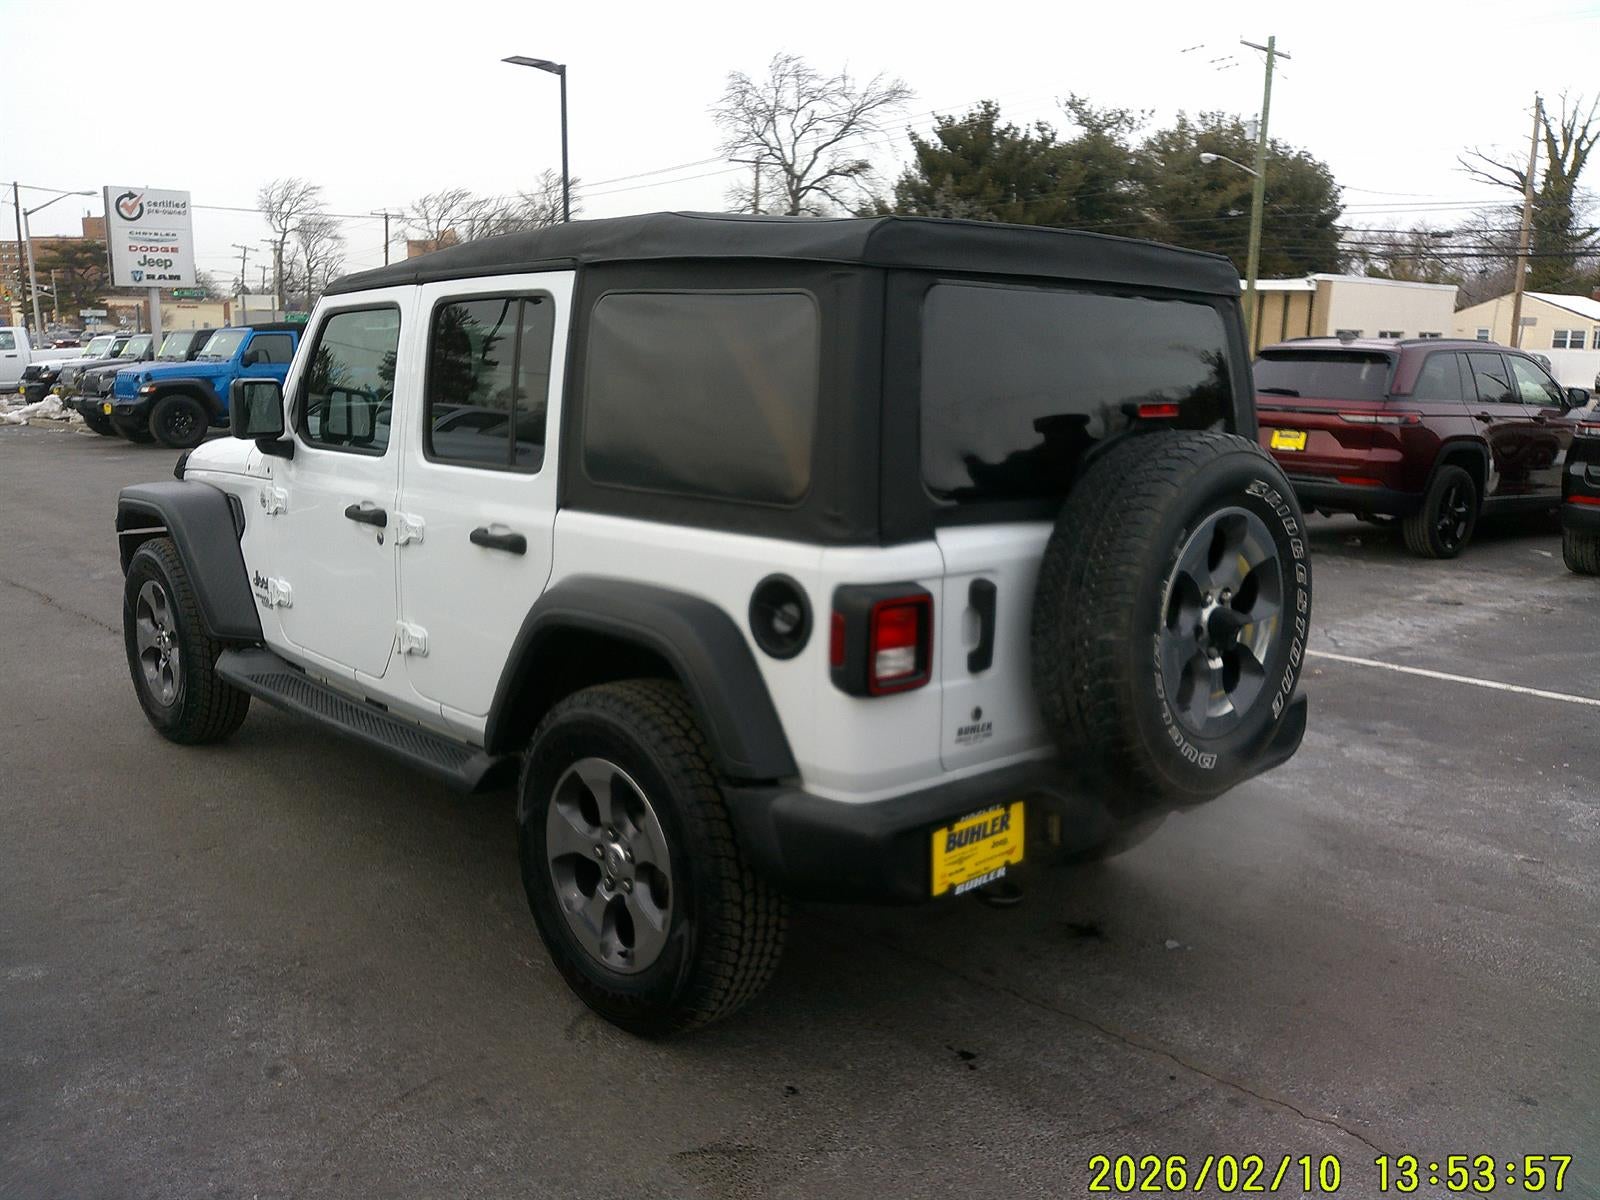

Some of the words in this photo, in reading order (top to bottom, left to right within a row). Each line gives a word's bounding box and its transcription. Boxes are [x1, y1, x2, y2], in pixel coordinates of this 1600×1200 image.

[147, 200, 187, 209] certified
[147, 208, 187, 216] pre-owned
[128, 245, 179, 253] DODGE
[137, 254, 173, 270] Jeep
[146, 273, 181, 281] RAM
[1245, 478, 1313, 721] BRIDGESTONE
[944, 811, 1011, 854] BUHLER
[953, 866, 1007, 896] BUHLER
